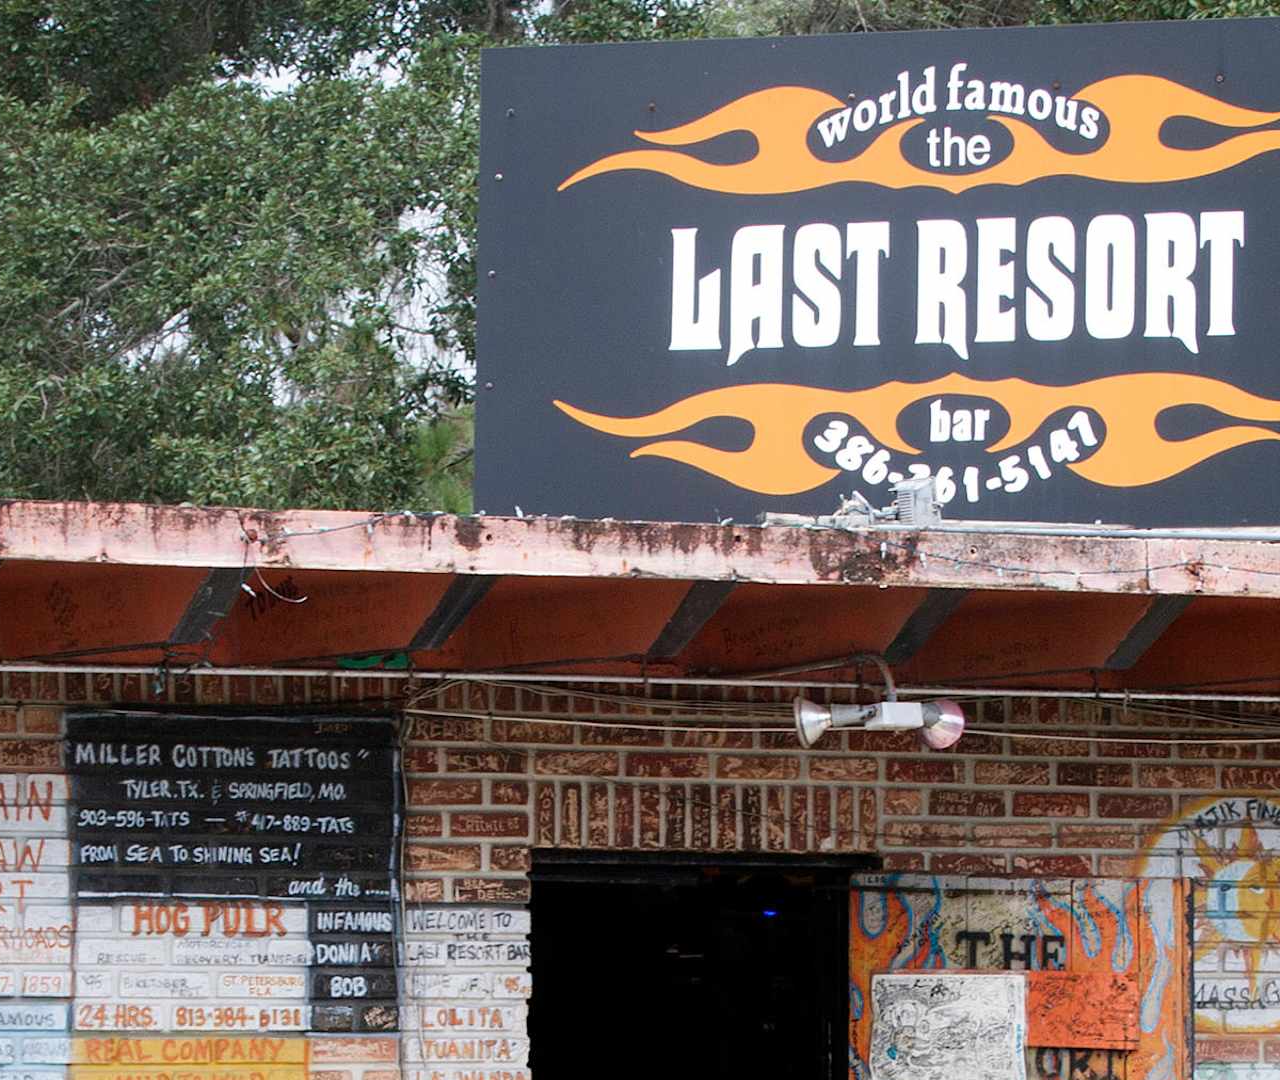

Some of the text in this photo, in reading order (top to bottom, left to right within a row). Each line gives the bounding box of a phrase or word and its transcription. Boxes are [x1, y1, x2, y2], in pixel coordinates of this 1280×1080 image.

[816, 63, 1102, 149] world famous
[926, 128, 991, 168] the
[667, 211, 1245, 368] LAST RESORT
[930, 399, 991, 442] bar
[75, 744, 161, 767] MILLER
[80, 842, 301, 866] FROM SEA TO SHINING SEA!
[287, 877, 325, 897] and
[131, 901, 191, 937] HOG
[317, 911, 393, 933] INFAMOUS
[407, 910, 512, 931] WELCOME TO
[956, 930, 1066, 971] THE
[330, 975, 369, 999] BOB
[78, 1004, 158, 1028] 24 HRS.
[422, 1007, 504, 1029] LOLITA
[84, 1038, 154, 1062] REAL
[161, 1038, 286, 1062] COMPANY
